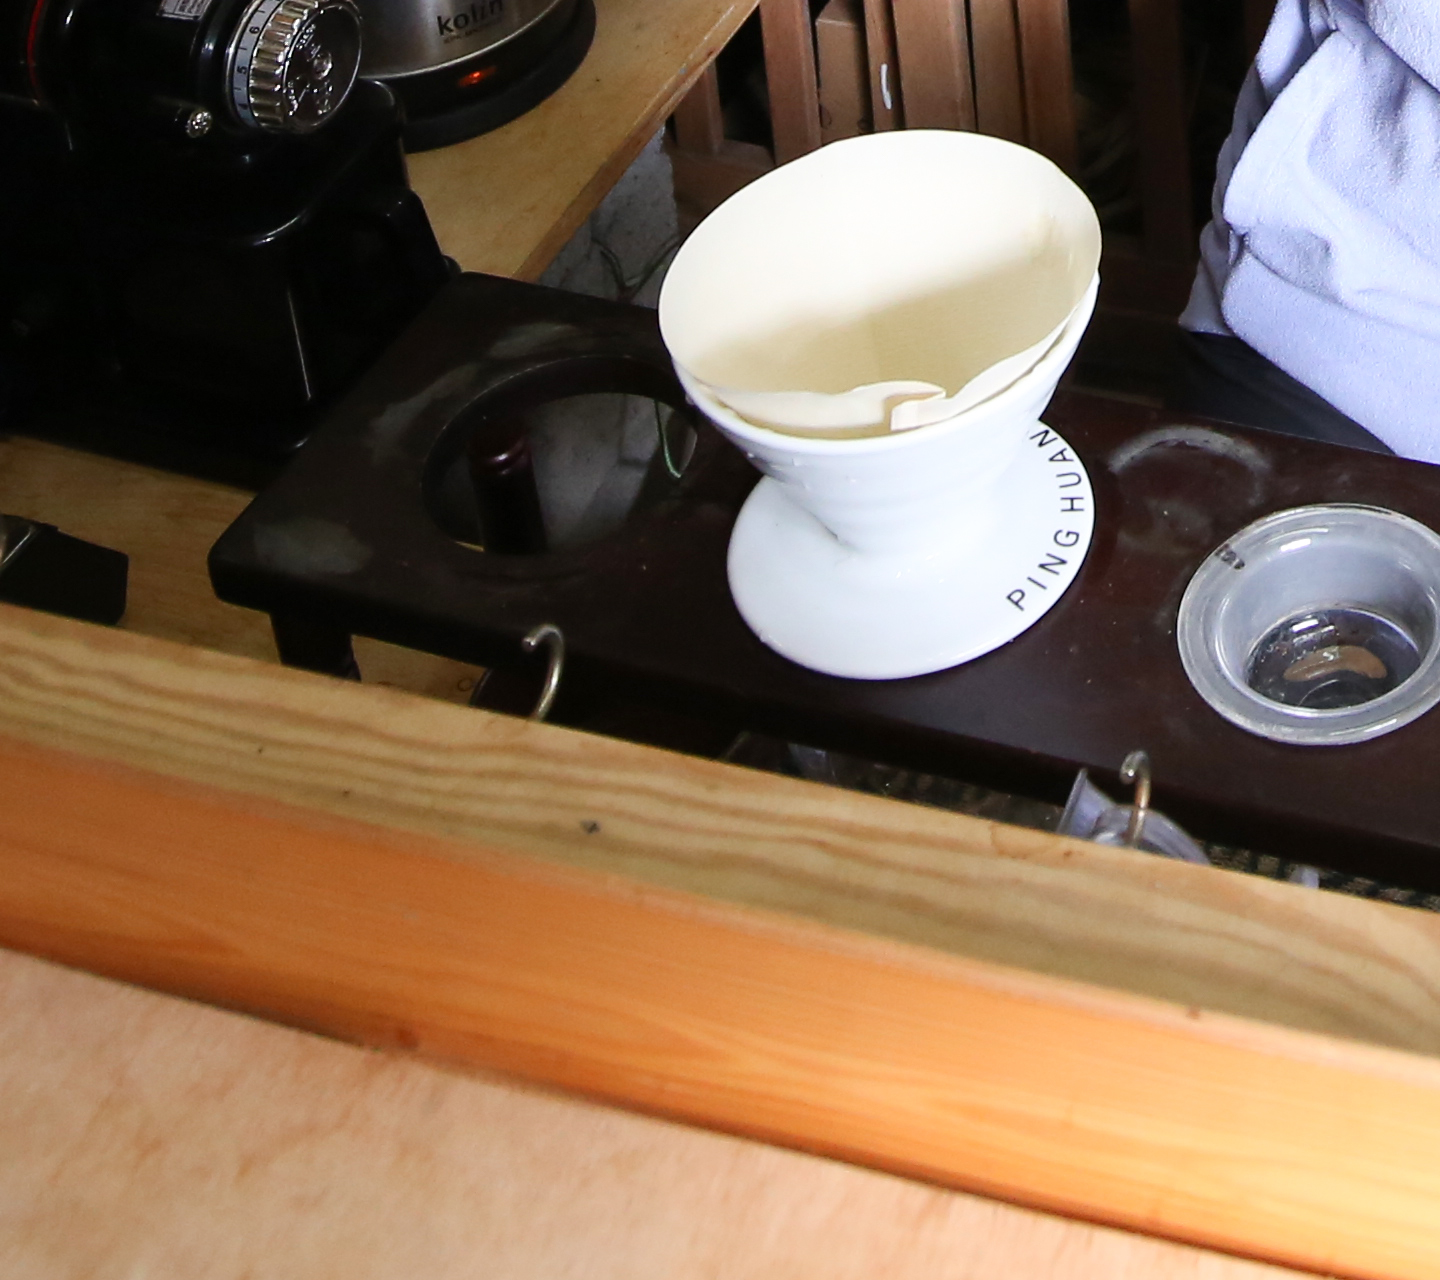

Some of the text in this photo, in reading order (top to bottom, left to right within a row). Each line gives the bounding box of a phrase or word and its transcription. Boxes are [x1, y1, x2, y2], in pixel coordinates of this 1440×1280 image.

[249, 26, 260, 35] 6
[236, 65, 248, 75] 5
[1006, 429, 1085, 612] PING HUAN
